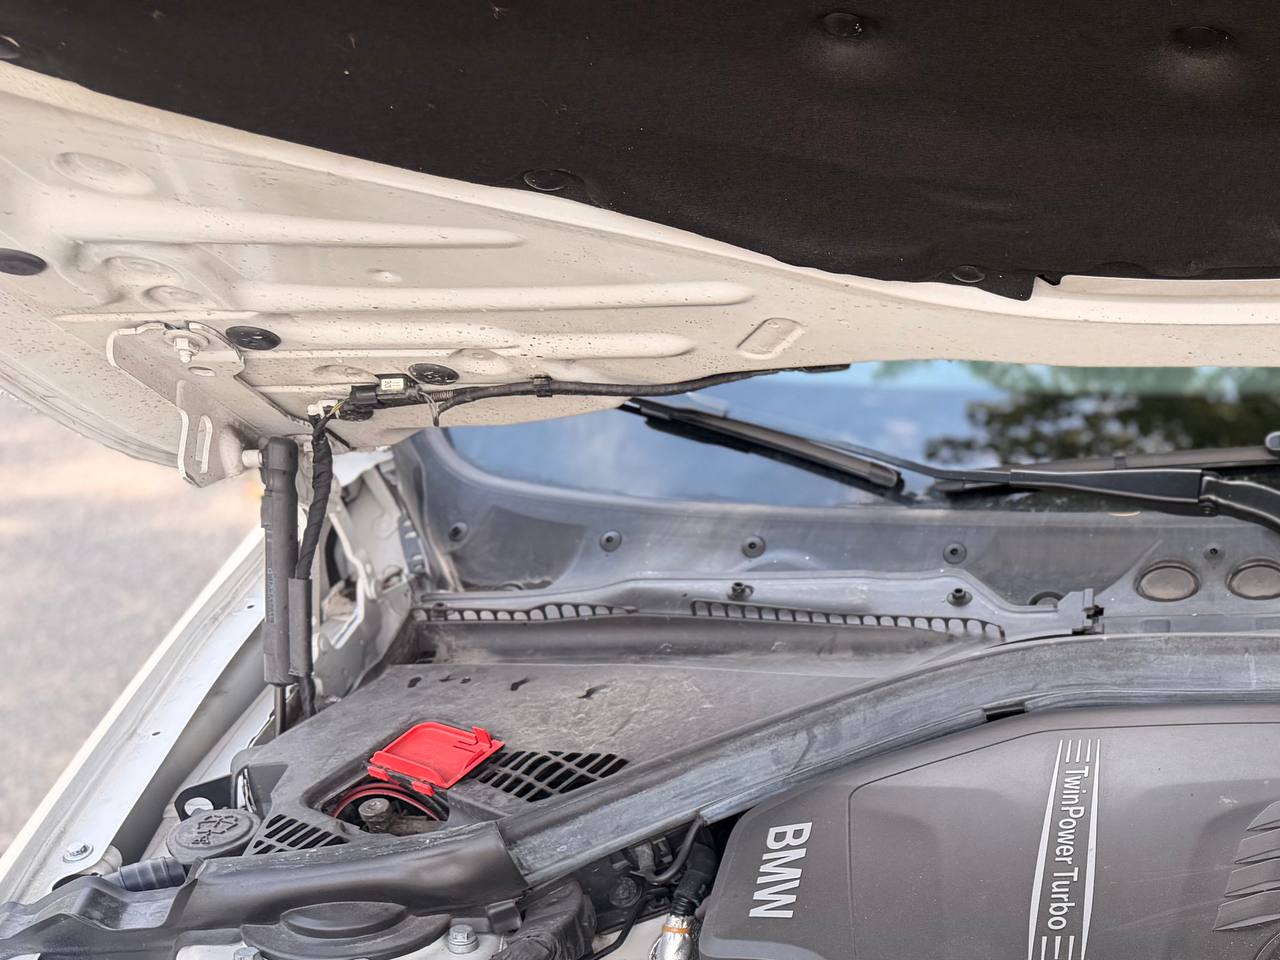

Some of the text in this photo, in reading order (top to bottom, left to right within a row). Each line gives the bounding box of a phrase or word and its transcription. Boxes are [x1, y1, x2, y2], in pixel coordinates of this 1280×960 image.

[748, 821, 813, 918] BMW
[1047, 766, 1089, 931] TwinPower Turbo
